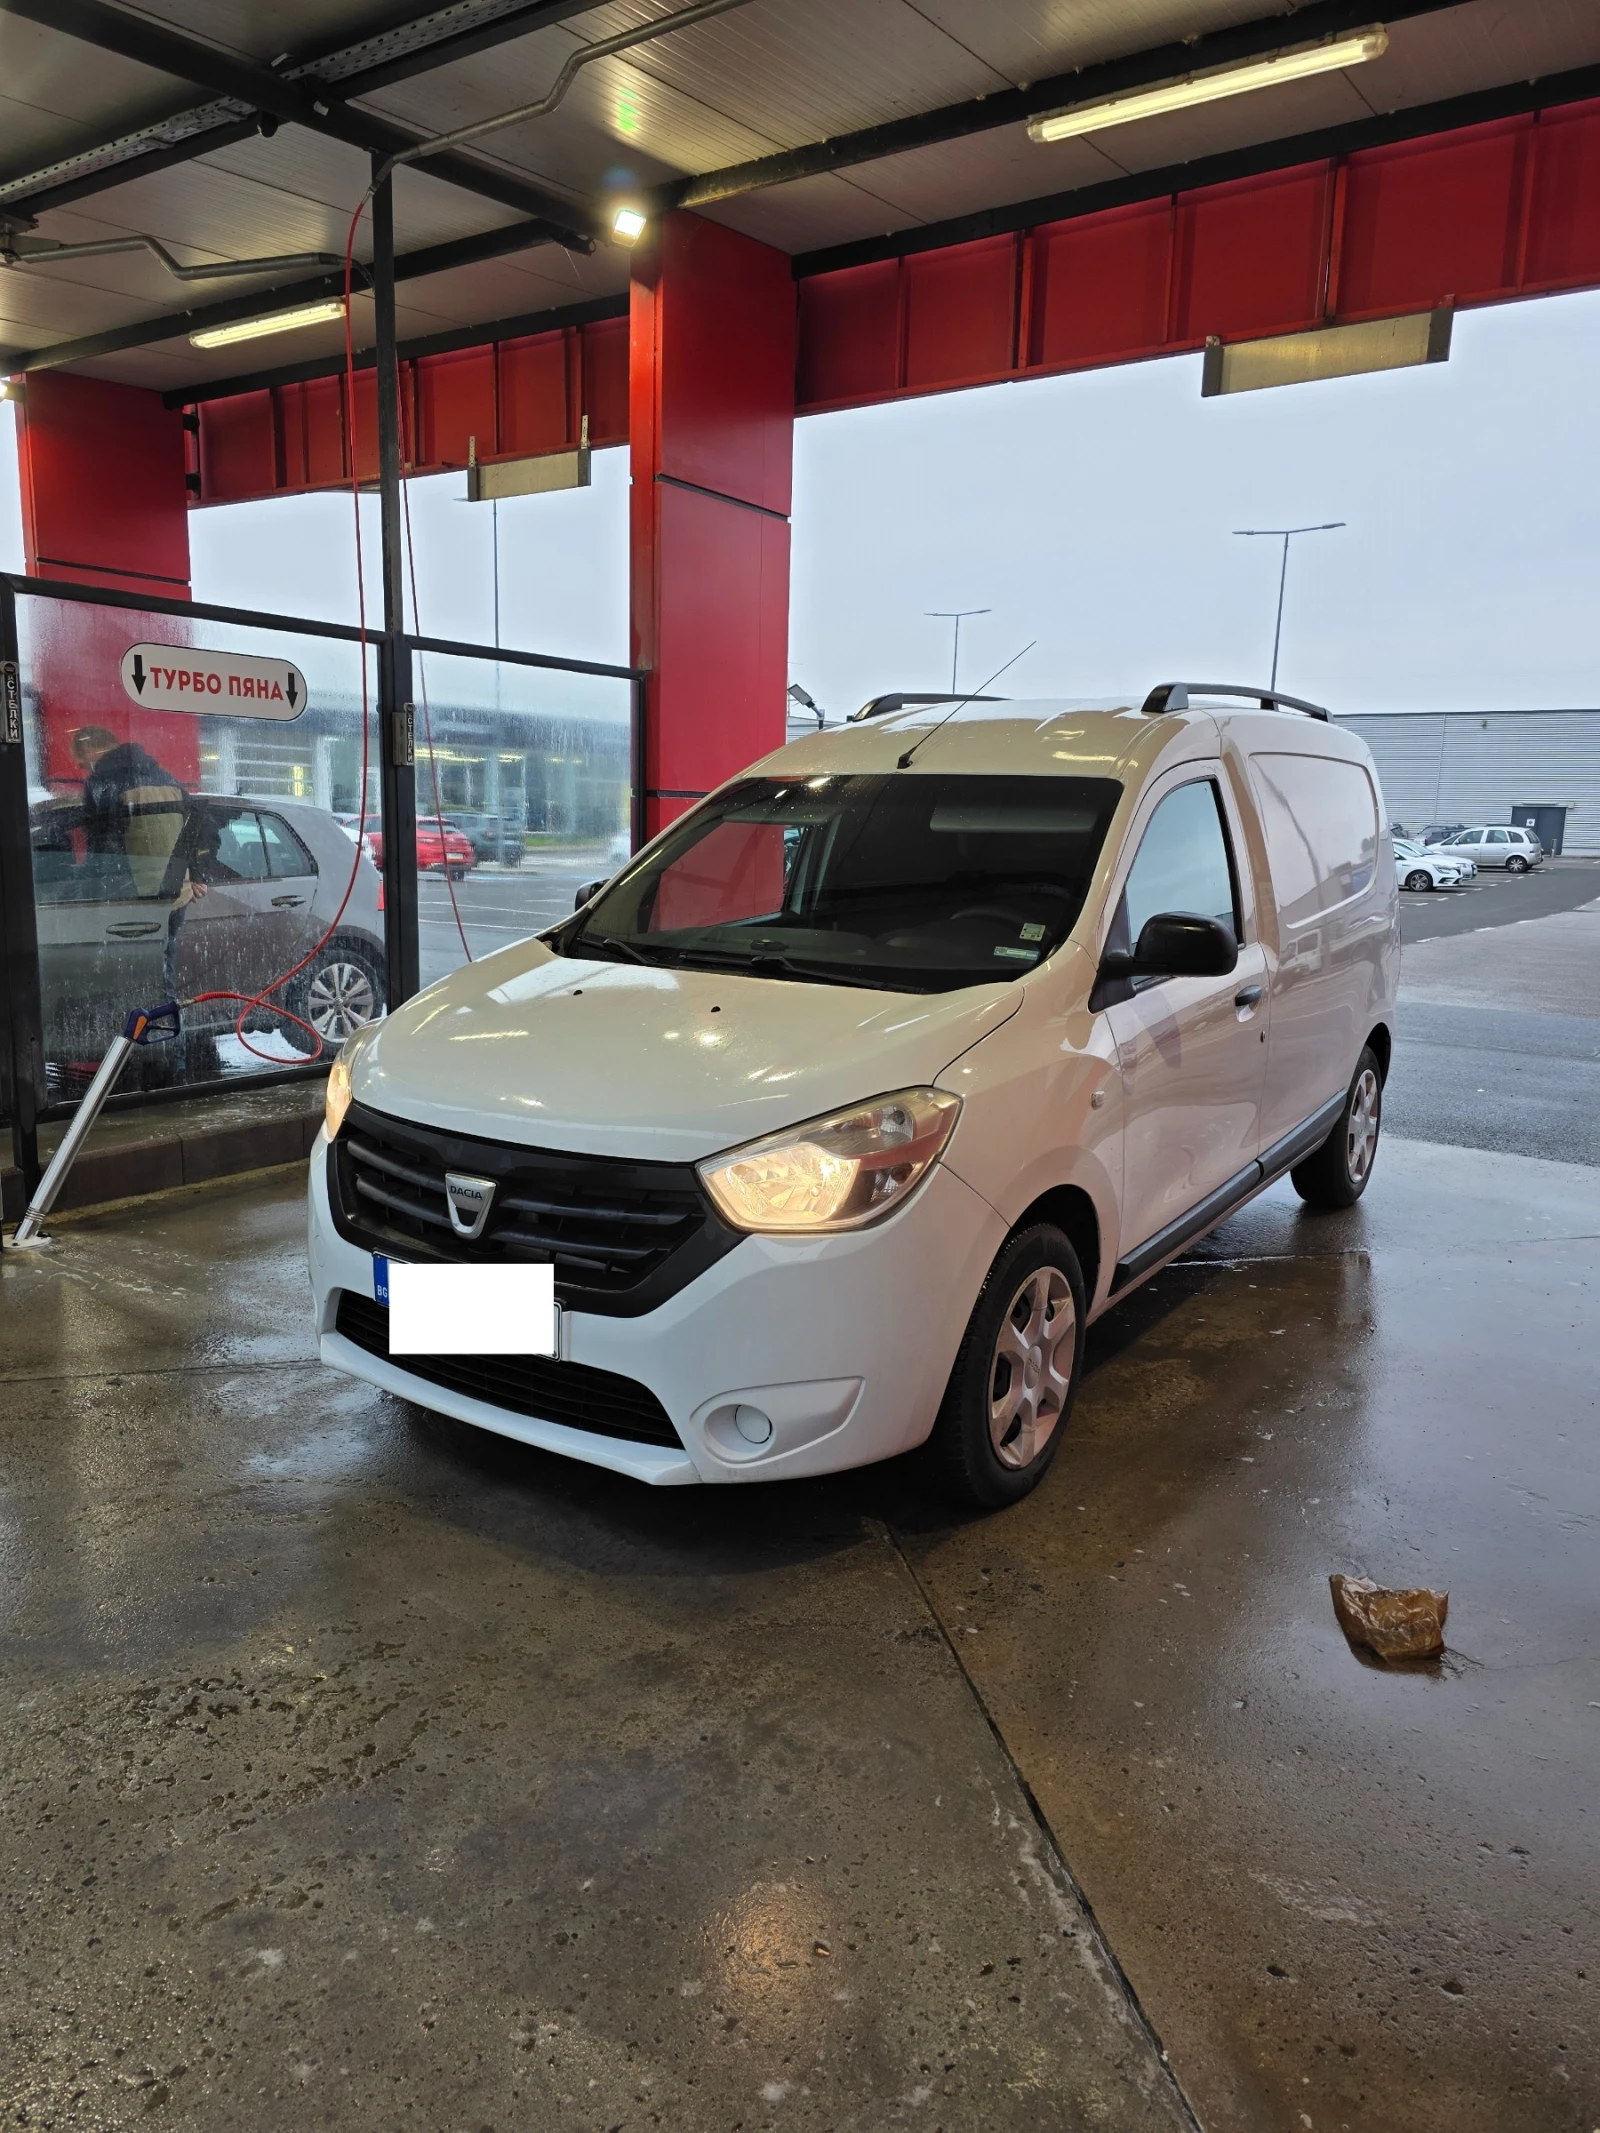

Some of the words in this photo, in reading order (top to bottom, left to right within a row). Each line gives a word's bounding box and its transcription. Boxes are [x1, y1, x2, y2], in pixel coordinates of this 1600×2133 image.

[150, 667, 222, 695] ТУРБО
[228, 675, 284, 701] ПЯНА
[450, 1185, 483, 1200] DACIA
[377, 1284, 388, 1299] BG
